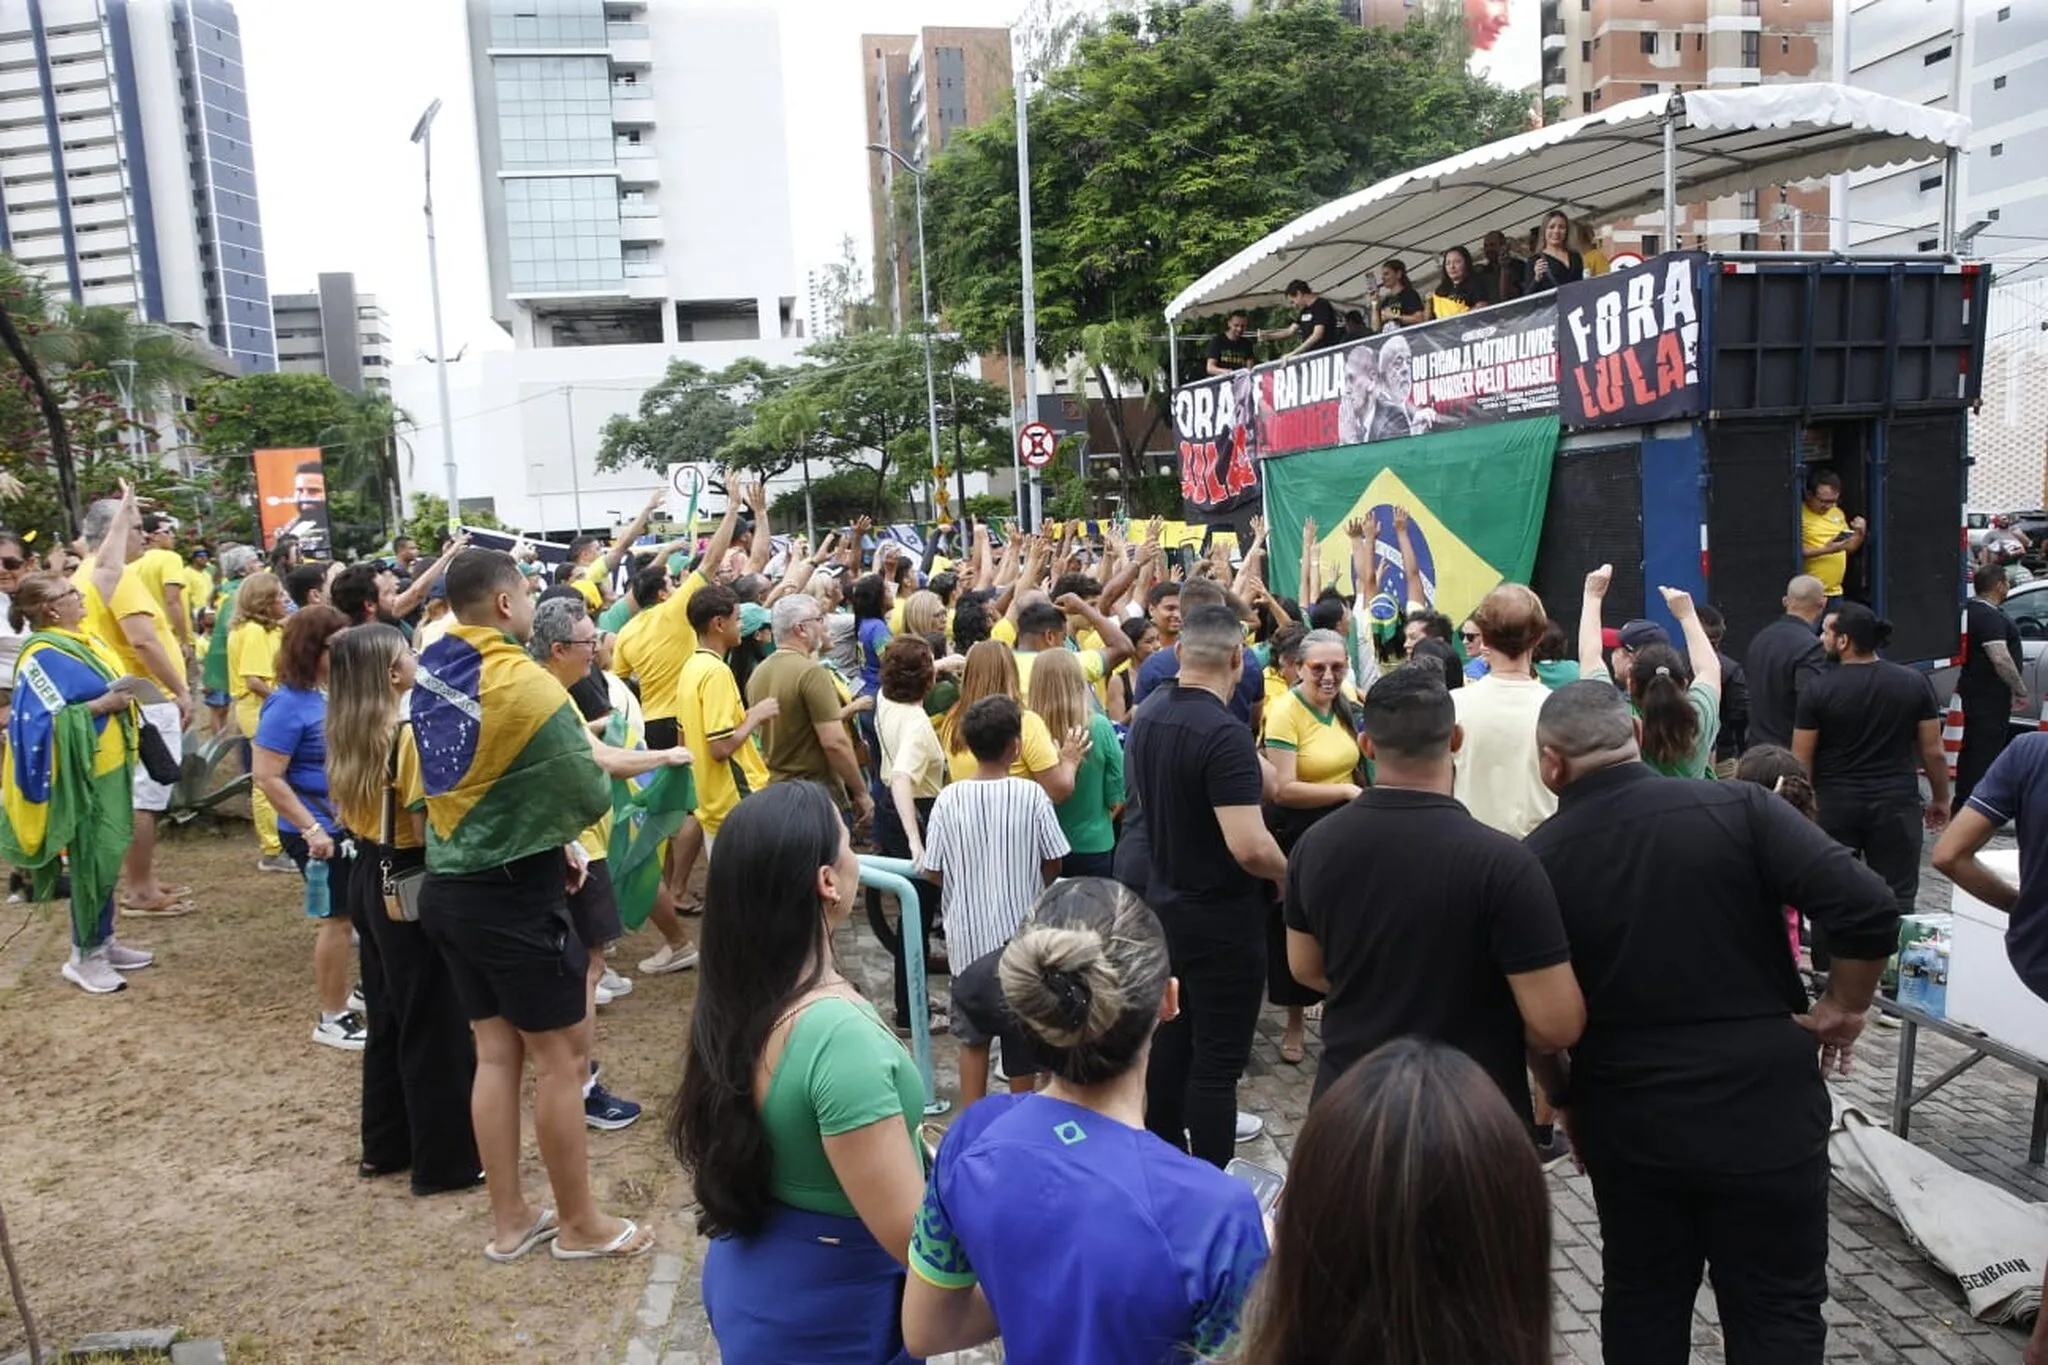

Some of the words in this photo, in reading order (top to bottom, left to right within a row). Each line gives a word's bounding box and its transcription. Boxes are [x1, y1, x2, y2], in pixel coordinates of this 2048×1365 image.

[1567, 259, 1697, 363] FORA
[1412, 354, 1427, 381] OU
[1429, 347, 1461, 379] FICAR
[1462, 344, 1472, 370] A
[1520, 325, 1556, 360] LIVRE
[1574, 322, 1699, 418] LULA!
[1171, 381, 1237, 439] ORA
[1252, 365, 1298, 415] FRA
[1301, 352, 1346, 405] LULA
[1413, 380, 1428, 407] OU
[1475, 365, 1505, 396] PELO
